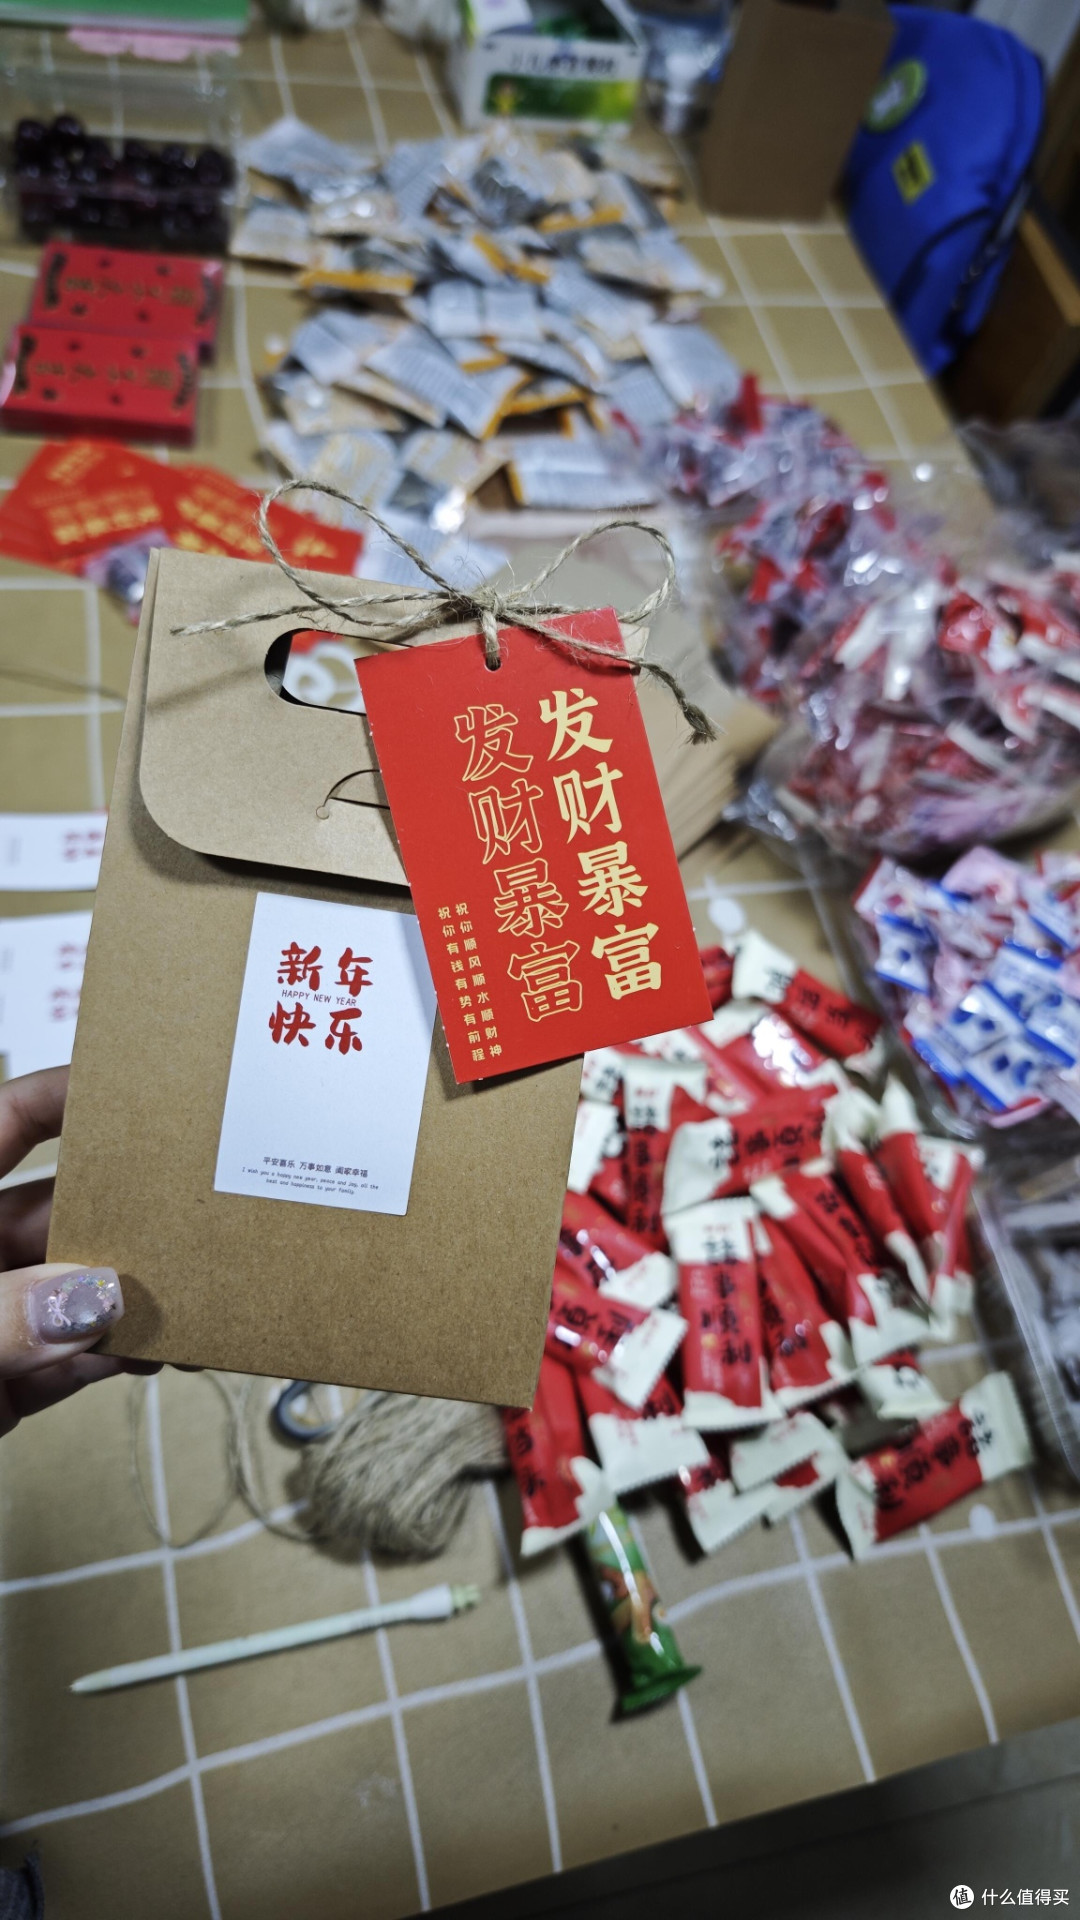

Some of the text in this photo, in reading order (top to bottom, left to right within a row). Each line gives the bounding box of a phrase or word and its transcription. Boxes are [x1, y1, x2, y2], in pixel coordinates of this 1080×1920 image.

[454, 704, 583, 1022] 发财暴富
[539, 688, 662, 1000] 发财暴富
[277, 941, 374, 998] 新年
[281, 989, 357, 1006] HAPPY NEW YEAR
[438, 906, 486, 1062] 祝你有钱有势有前程
[455, 902, 503, 1058] 祝你顺风顺水顺财神
[268, 1000, 363, 1056] 快乐
[263, 1156, 295, 1169] 平安喜乐
[299, 1162, 332, 1174] 万事如意
